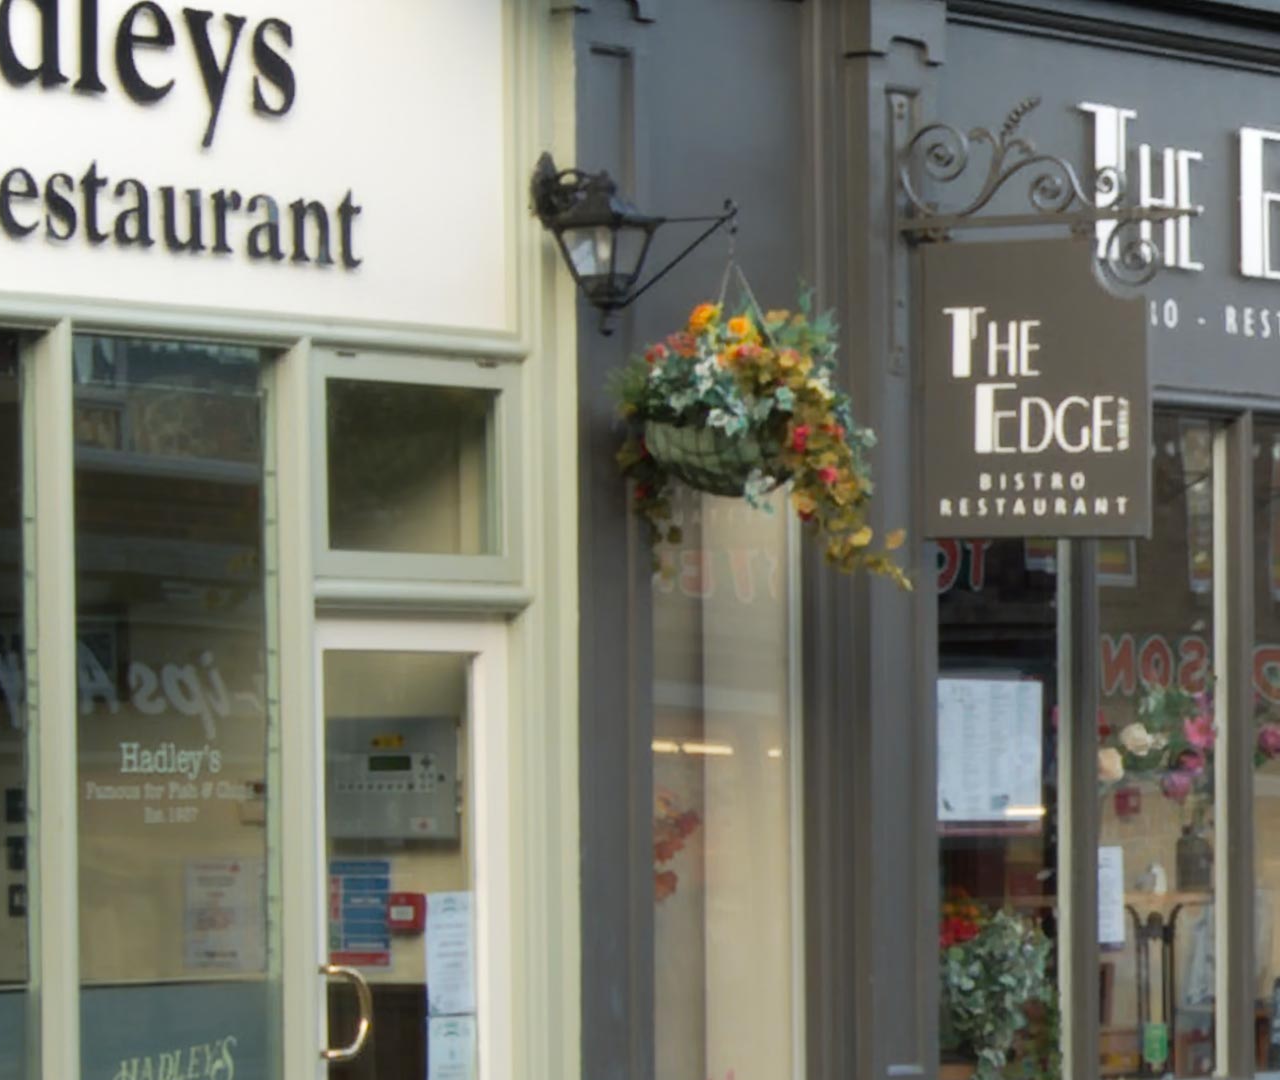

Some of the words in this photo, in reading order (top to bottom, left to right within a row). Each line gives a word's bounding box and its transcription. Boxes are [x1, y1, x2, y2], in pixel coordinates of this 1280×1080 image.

[942, 306, 1041, 378] THE
[975, 382, 1114, 453] EDGE
[979, 471, 1086, 491] BISTRO
[939, 497, 1128, 517] RESTAURANT
[119, 741, 222, 780] Hadley's
